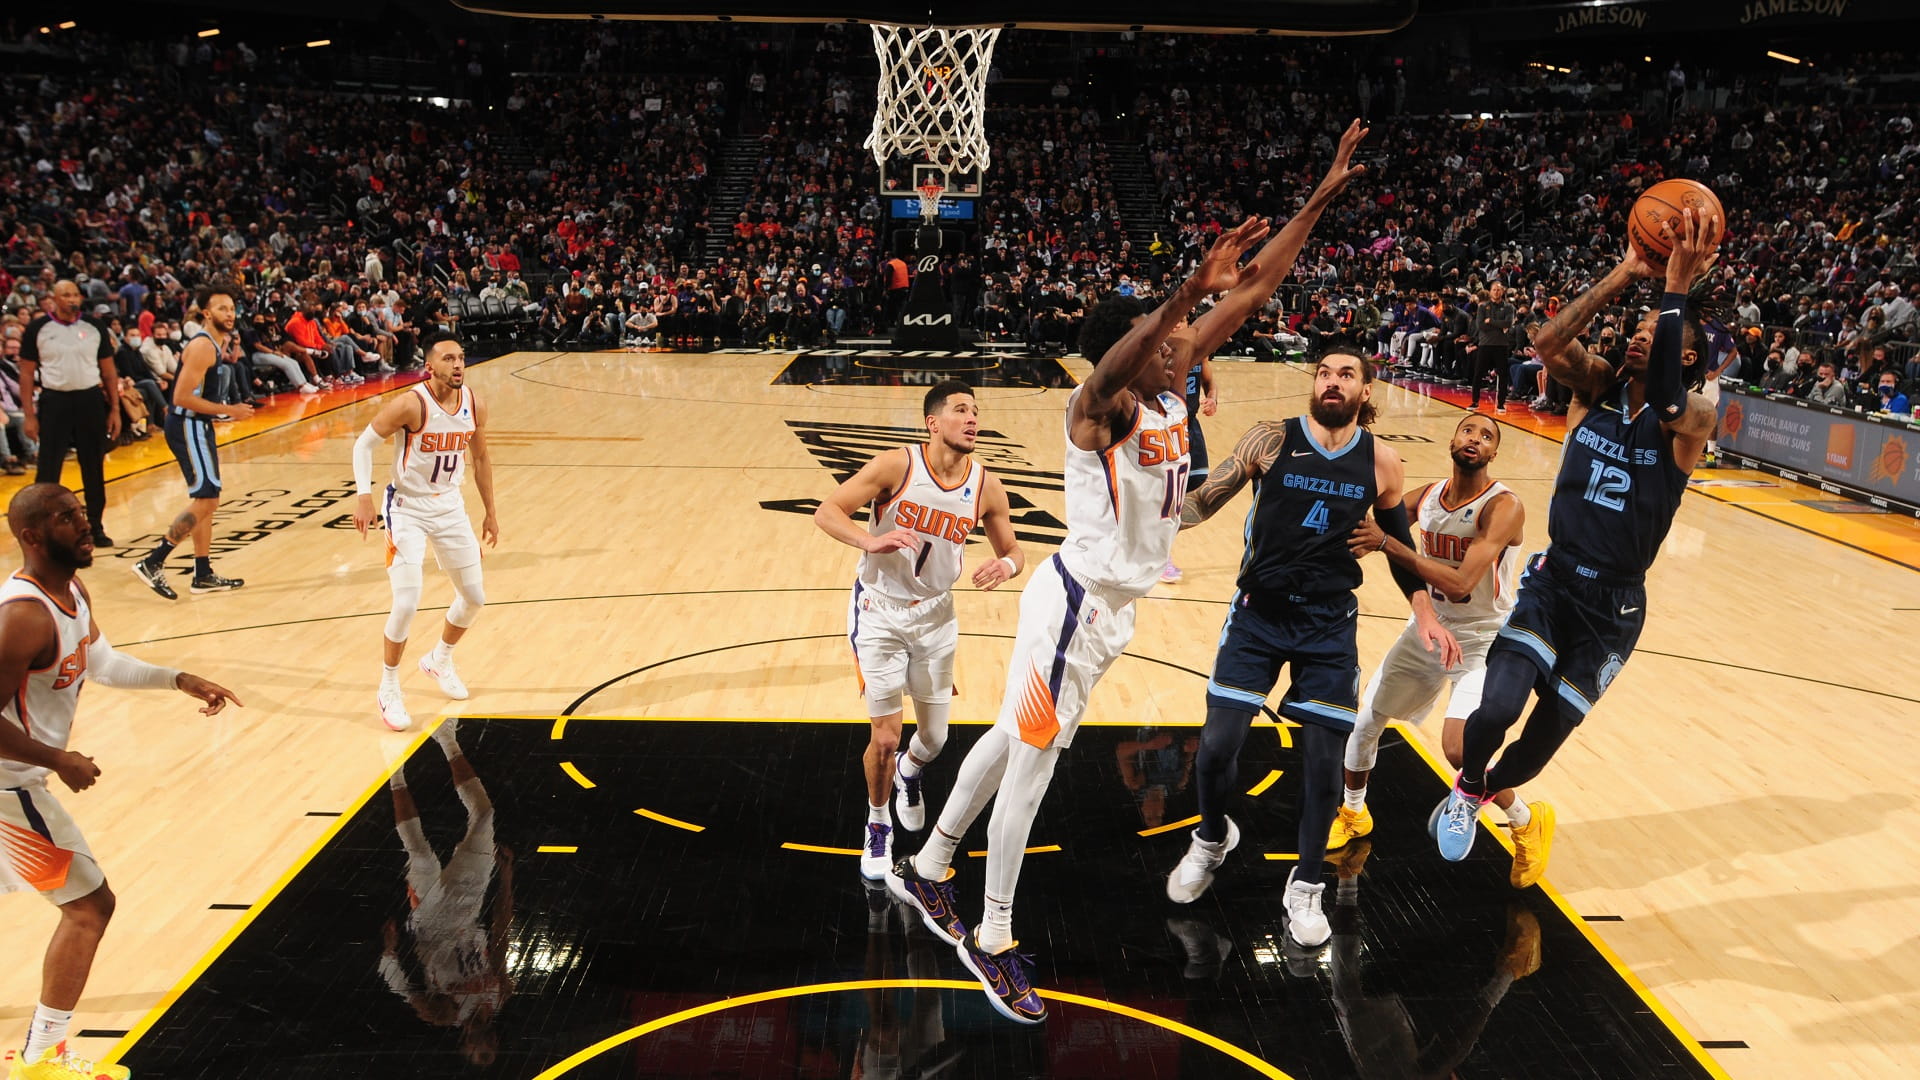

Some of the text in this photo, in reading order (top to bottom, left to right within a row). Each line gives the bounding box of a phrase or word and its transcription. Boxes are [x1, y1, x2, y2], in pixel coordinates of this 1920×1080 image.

[1555, 6, 1647, 33] JAMESON
[1740, 0, 1848, 24] JAMESON
[1748, 426, 1811, 452] THE PHOENIX SUNS
[1749, 411, 1811, 436] OFFICIAL BANK OF
[1575, 426, 1658, 465] GRIZZLES
[430, 454, 458, 483] 14
[1161, 462, 1189, 519] 10
[1283, 473, 1365, 500] GRIZZLIES
[1583, 458, 1631, 512] 12
[895, 500, 974, 545] SUNS
[1301, 499, 1330, 535] 4
[914, 540, 933, 578] 1
